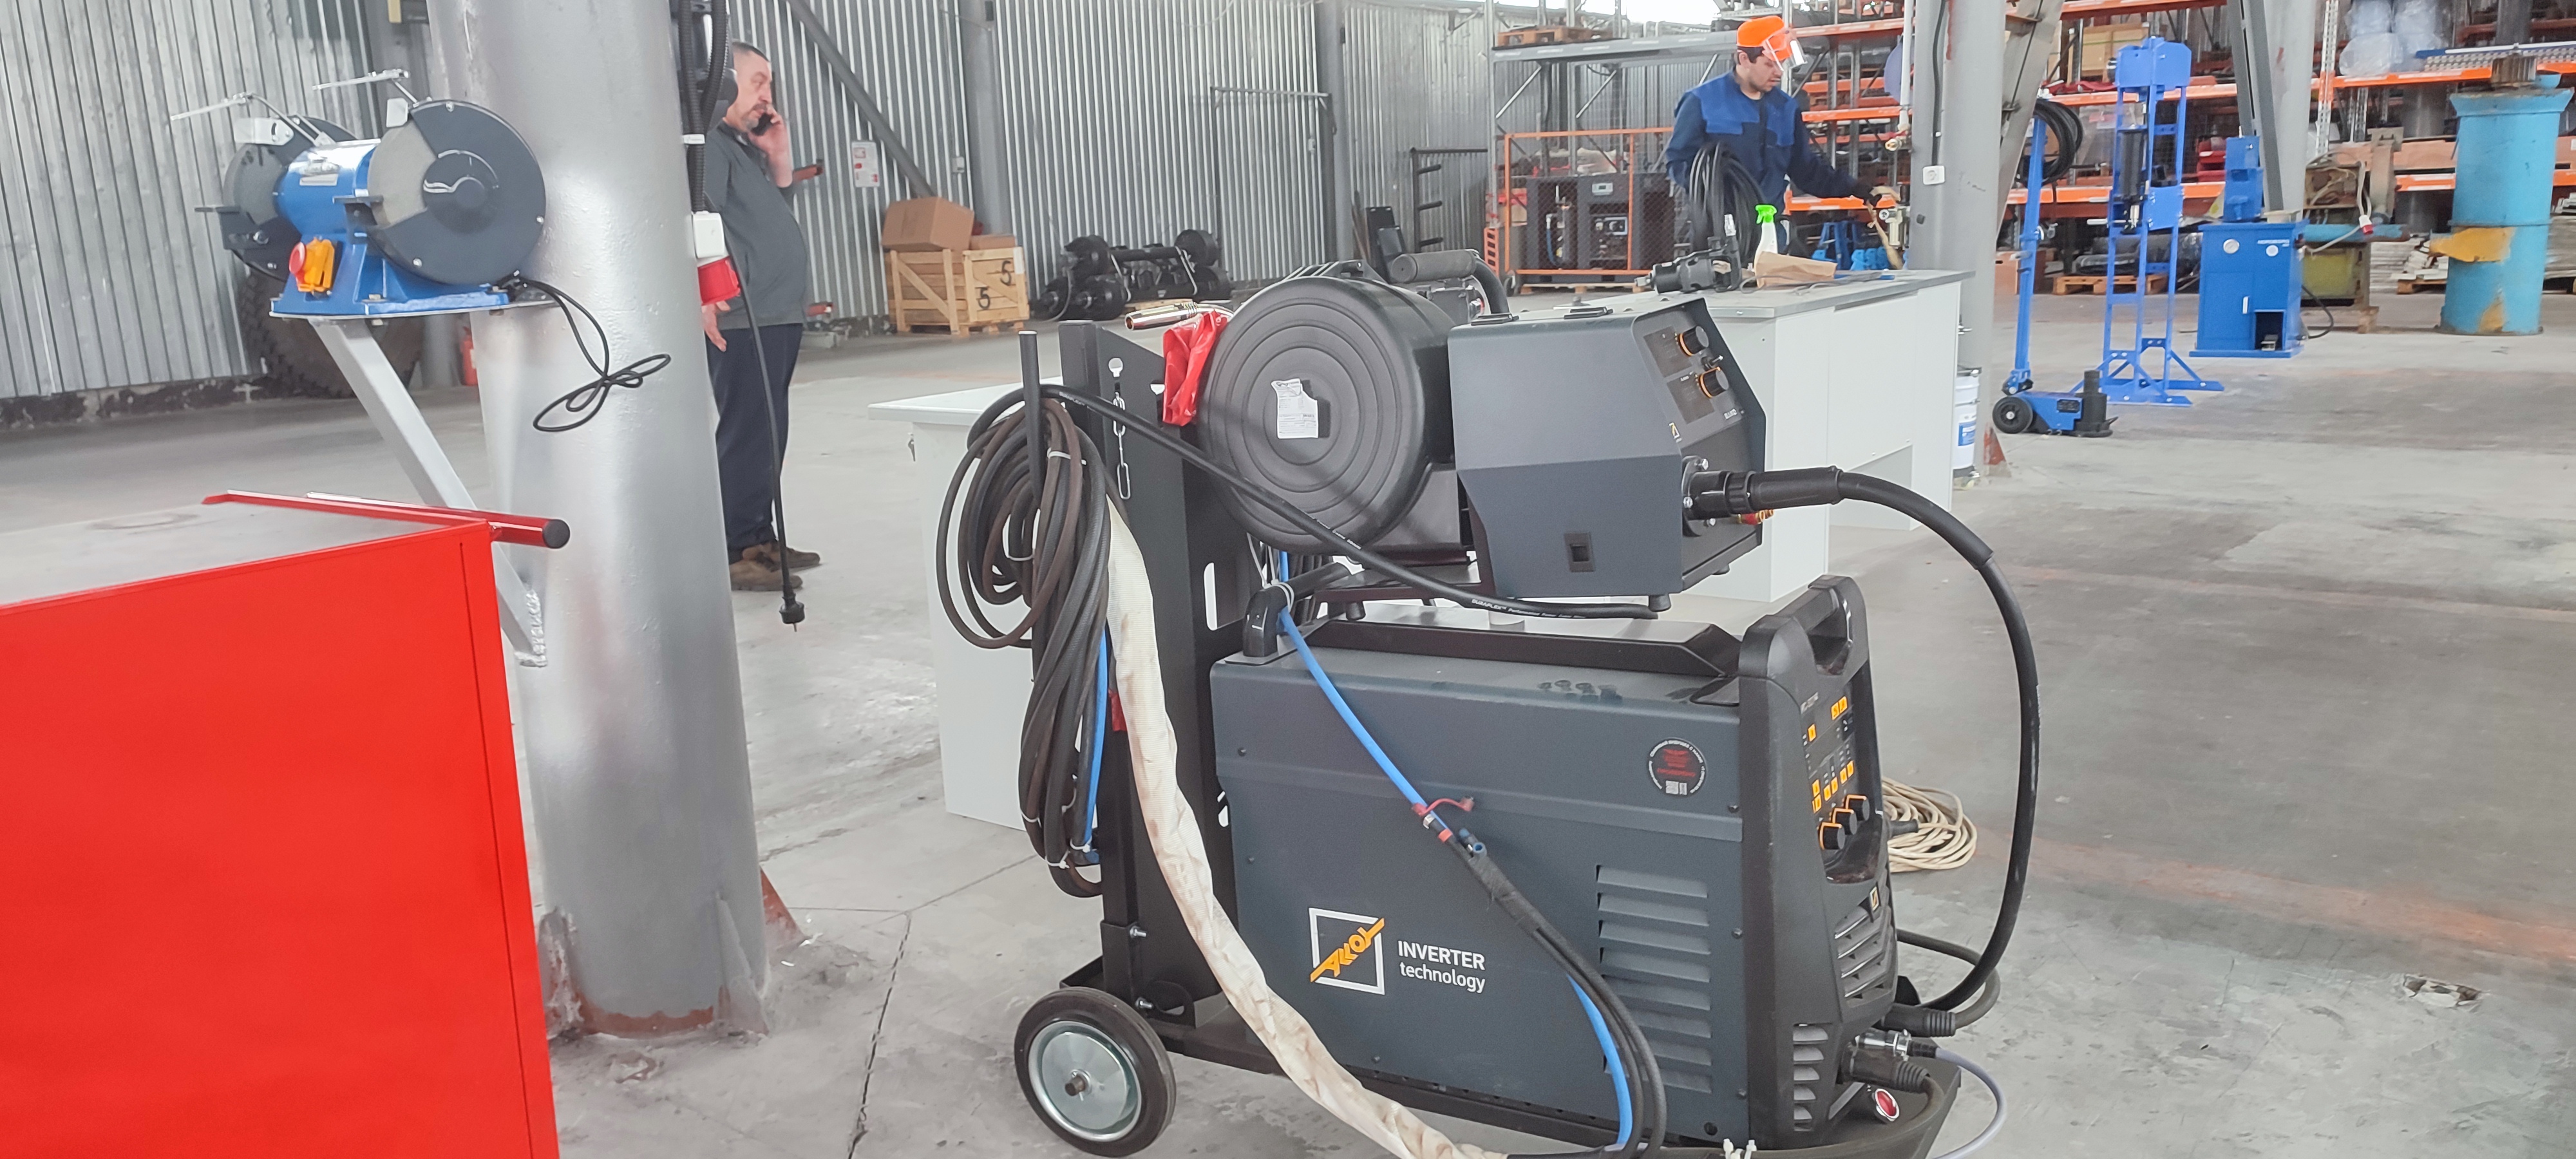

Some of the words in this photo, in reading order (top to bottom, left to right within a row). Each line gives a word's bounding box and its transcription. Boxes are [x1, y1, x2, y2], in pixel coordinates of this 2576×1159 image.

[1000, 260, 1012, 286] 5
[978, 287, 990, 310] 5
[1397, 940, 1485, 970] INVERTER
[1399, 961, 1485, 994] technology
